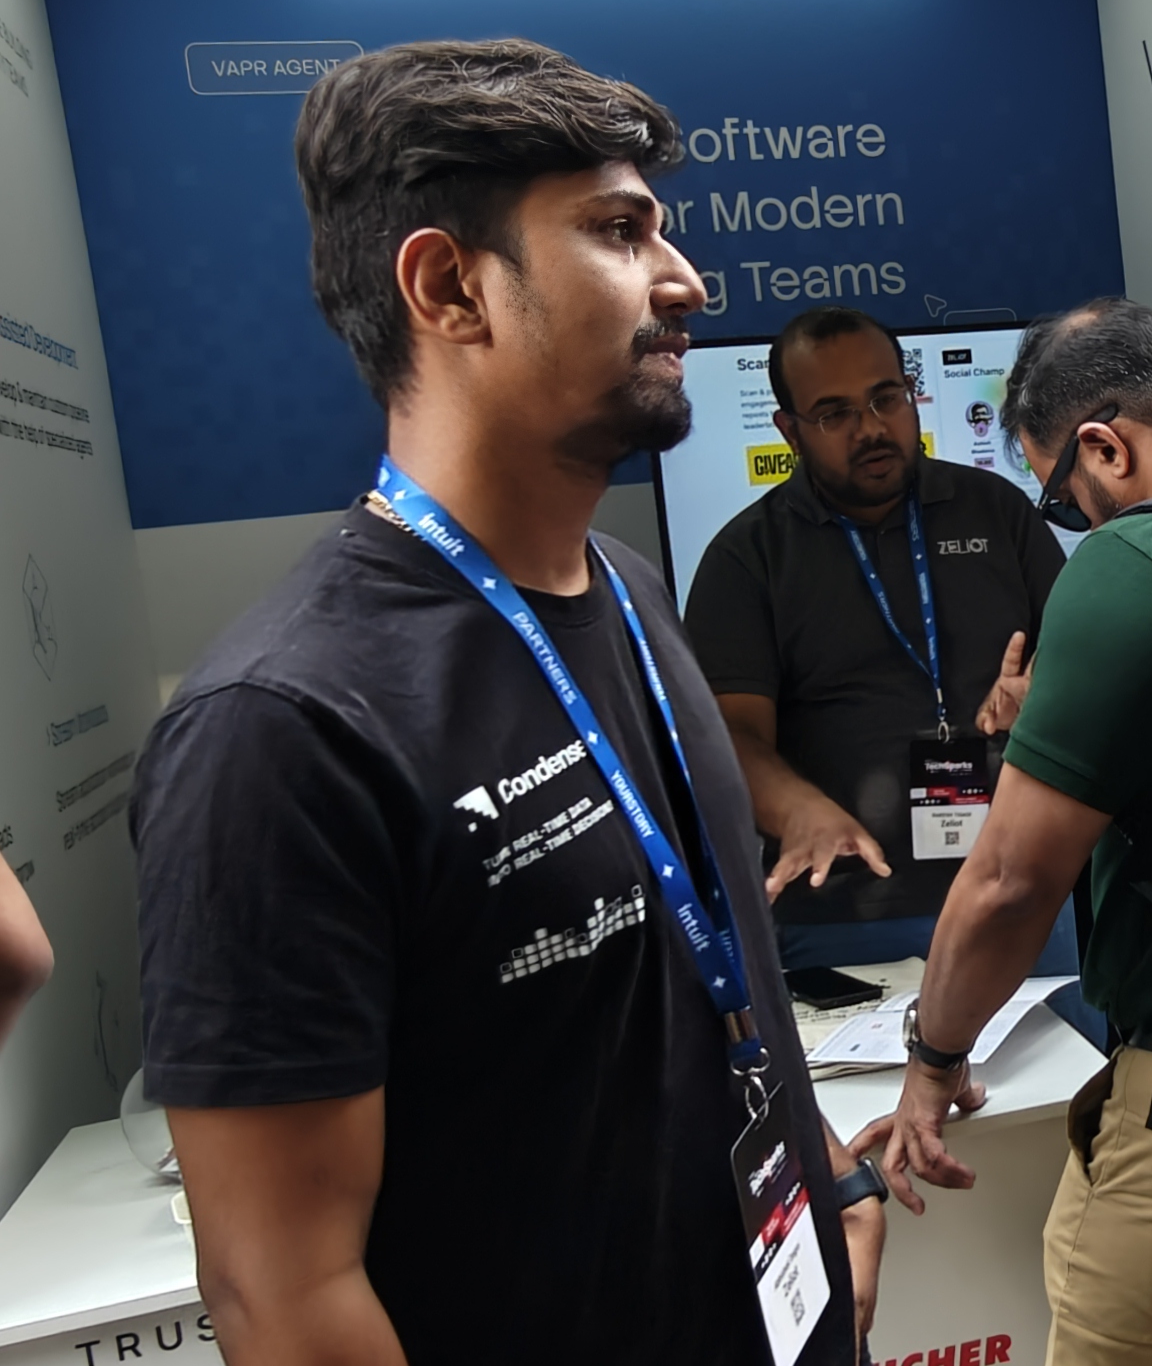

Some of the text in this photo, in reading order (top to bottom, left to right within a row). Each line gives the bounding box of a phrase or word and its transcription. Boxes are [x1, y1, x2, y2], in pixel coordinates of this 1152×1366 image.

[211, 58, 341, 77] VAPR AGENT
[688, 117, 886, 163] oftware
[710, 186, 905, 234] Modern
[740, 260, 907, 302] Teams
[944, 369, 971, 379] Social
[753, 452, 796, 476] GIVEA
[936, 538, 989, 555] ZELIOT
[512, 611, 578, 706] PARTNERS
[610, 769, 656, 839] YOURSTORY
